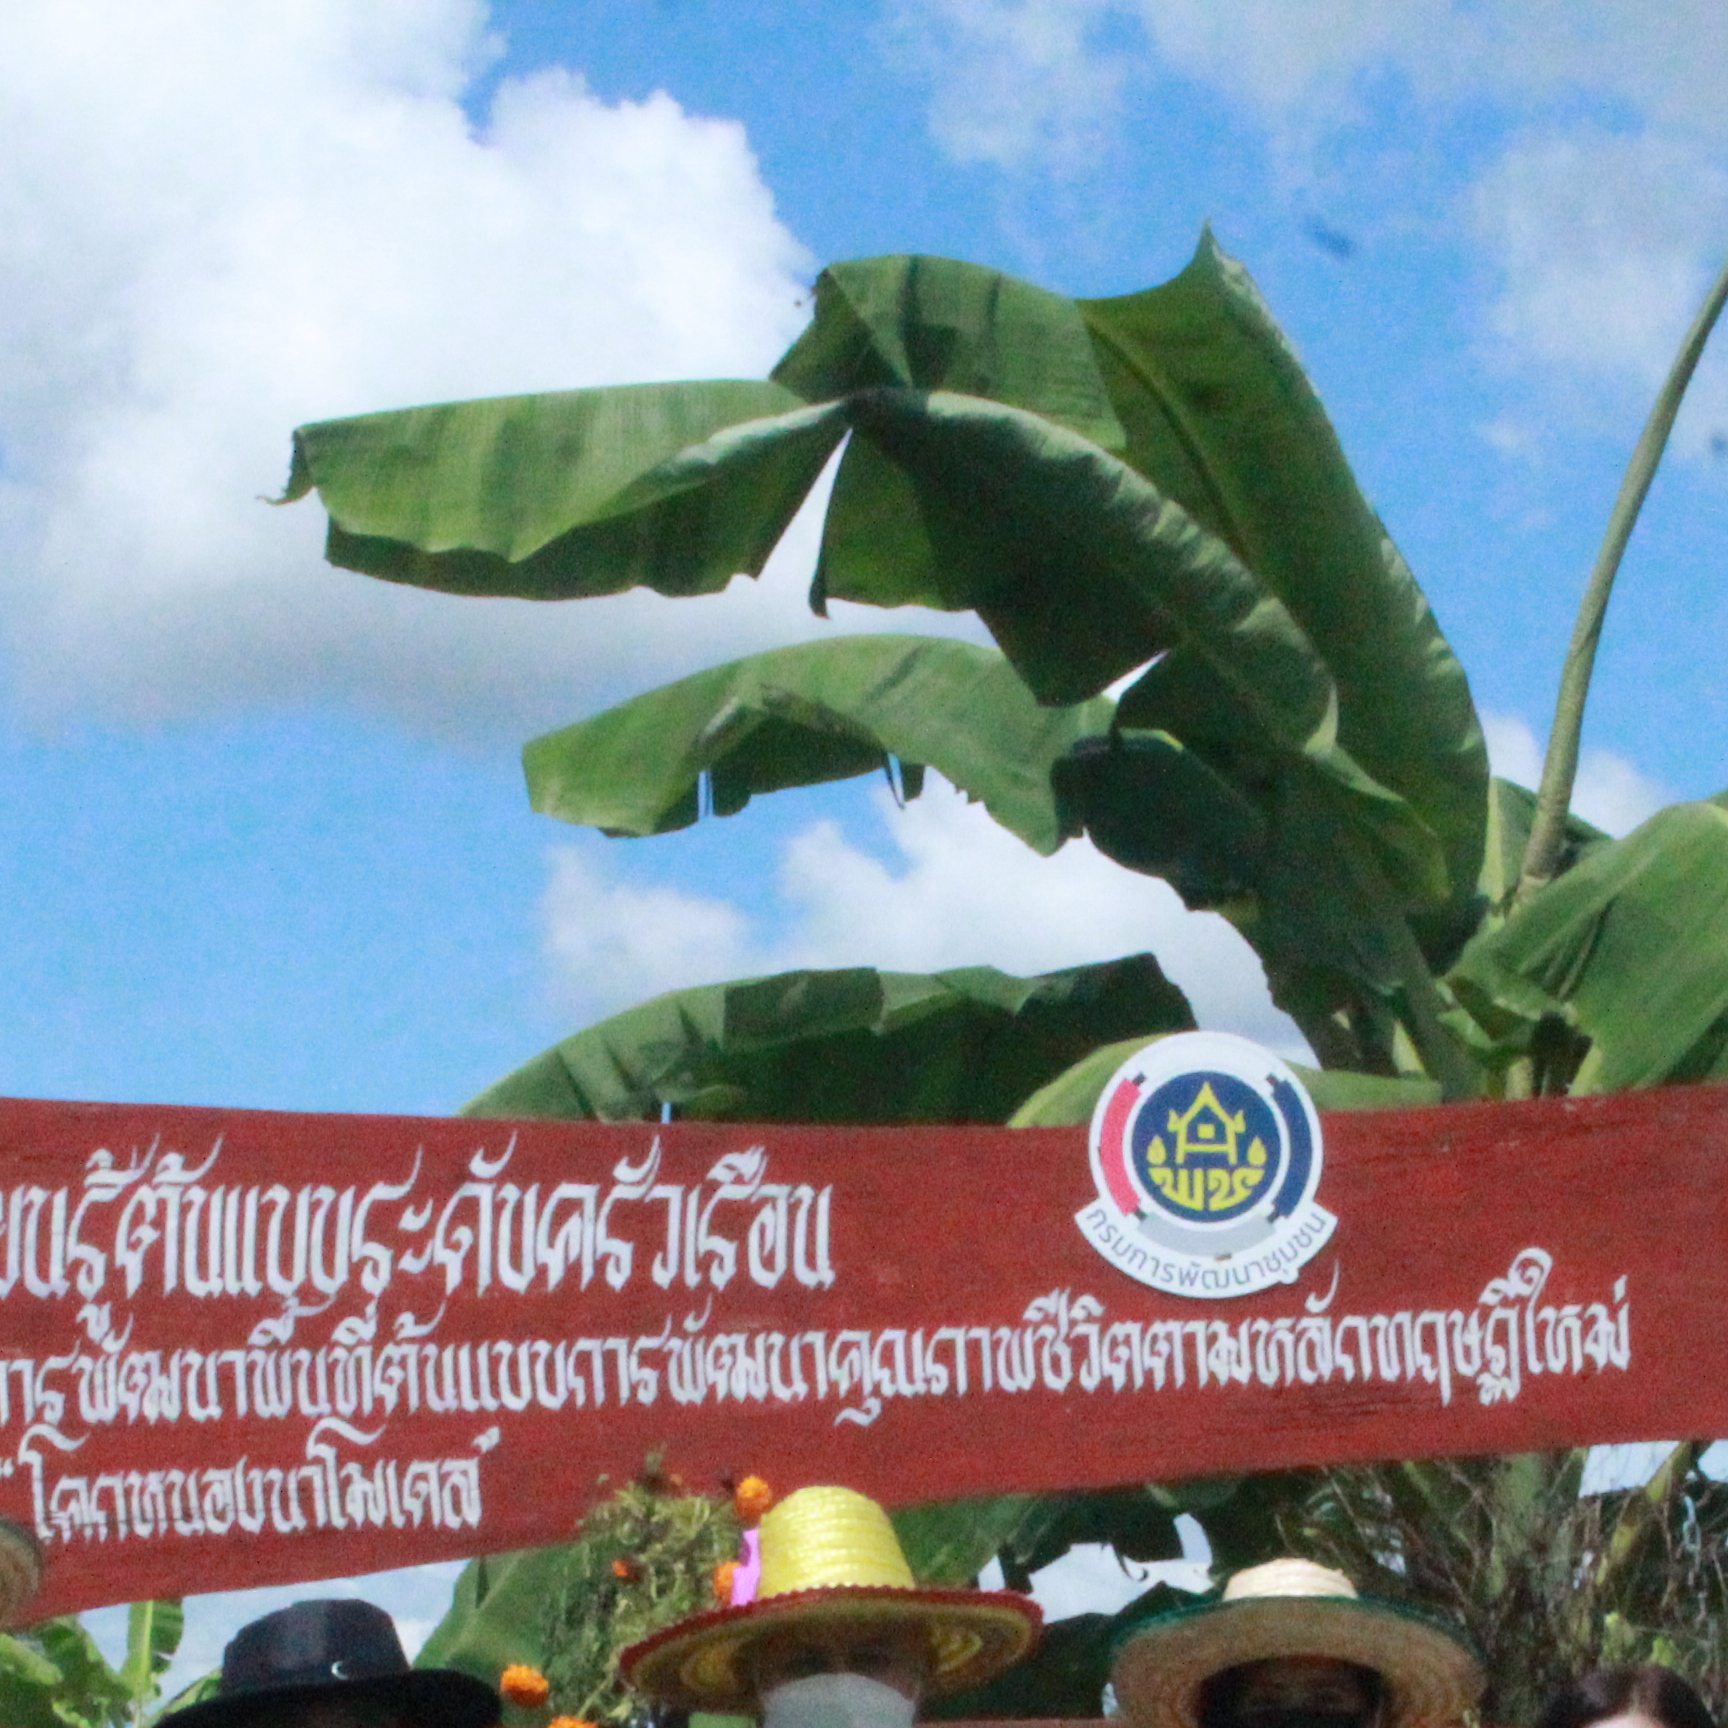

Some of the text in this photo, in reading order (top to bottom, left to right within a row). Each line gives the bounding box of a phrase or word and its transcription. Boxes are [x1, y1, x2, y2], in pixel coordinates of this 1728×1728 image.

[1086, 1207, 1327, 1291] กรมการพัฒนาชุมชน
